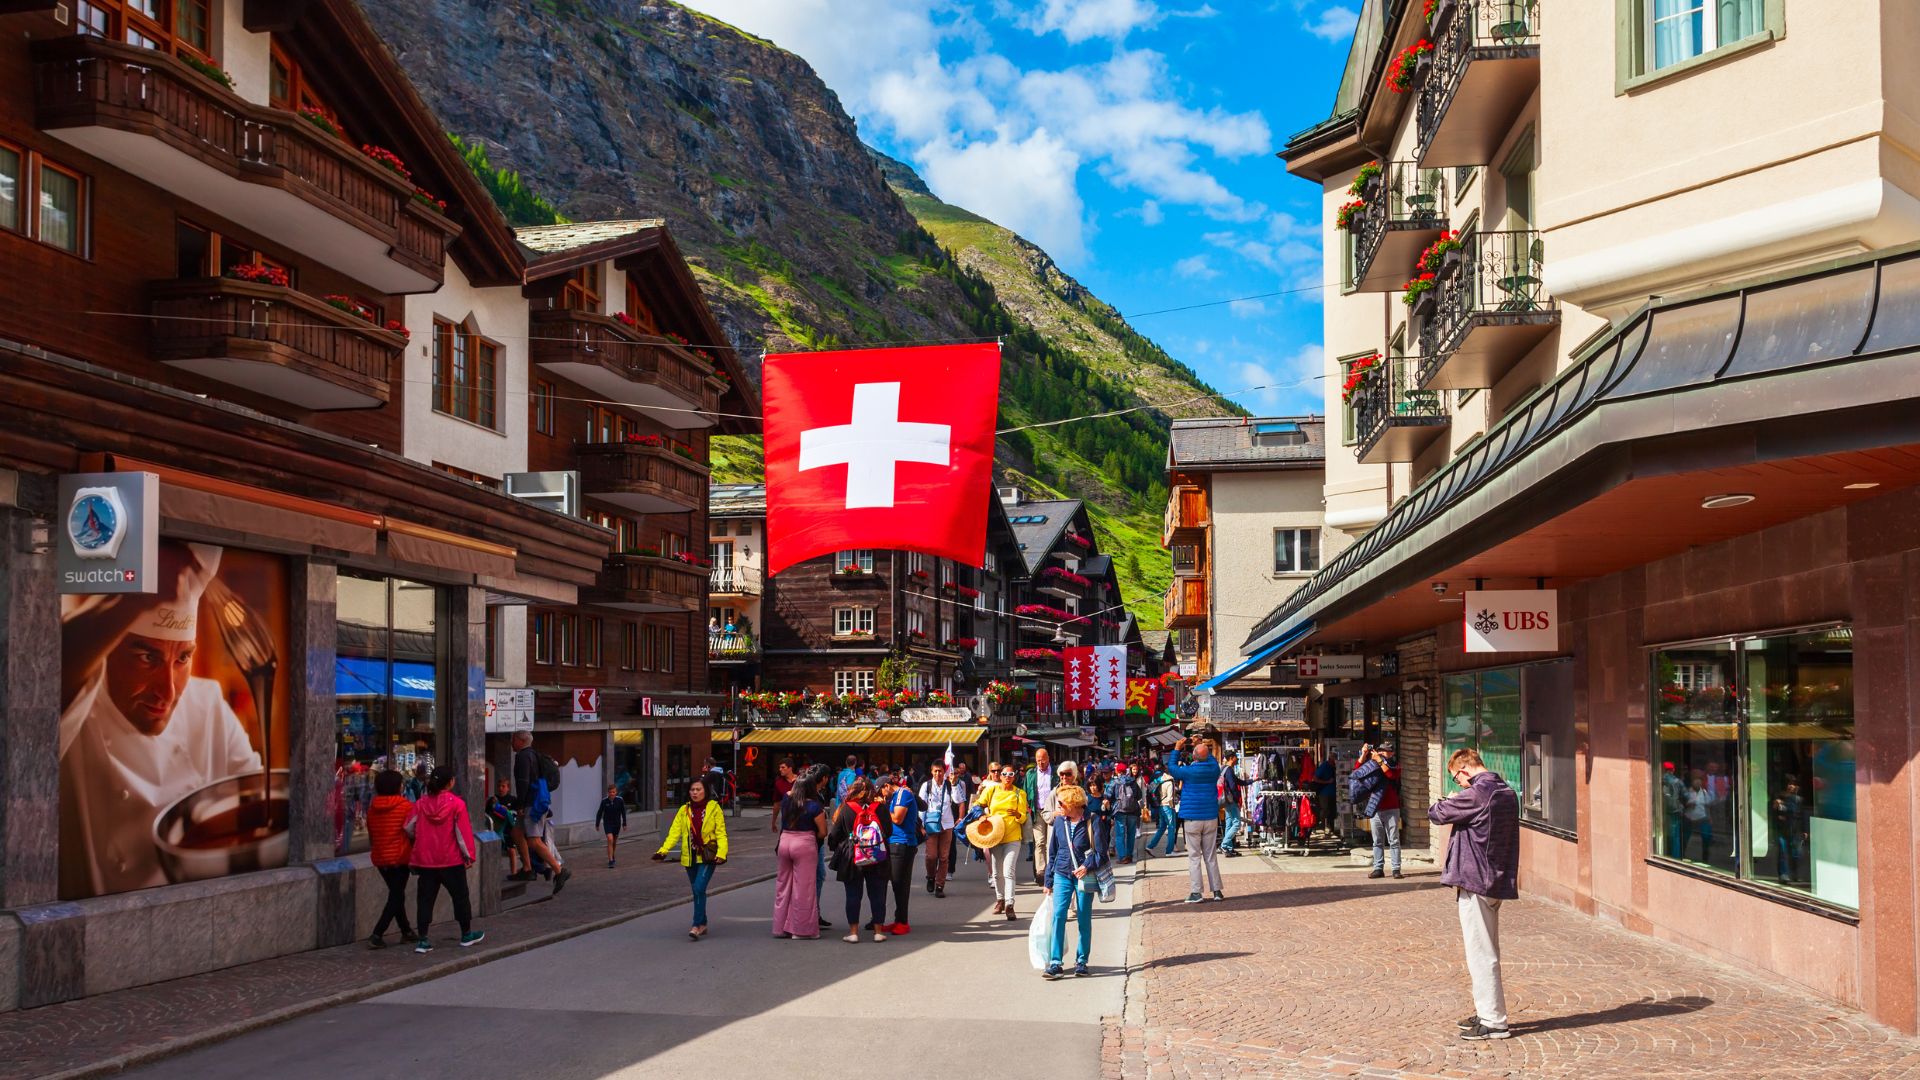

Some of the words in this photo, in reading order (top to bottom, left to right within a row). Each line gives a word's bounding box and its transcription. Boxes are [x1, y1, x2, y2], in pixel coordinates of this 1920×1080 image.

[65, 569, 123, 583] swatch
[152, 608, 192, 630] Lindt
[1502, 610, 1549, 630] UBS
[652, 704, 674, 717] Walliser
[675, 704, 710, 717] Kantonalbank
[1234, 701, 1287, 711] HUBLOT
